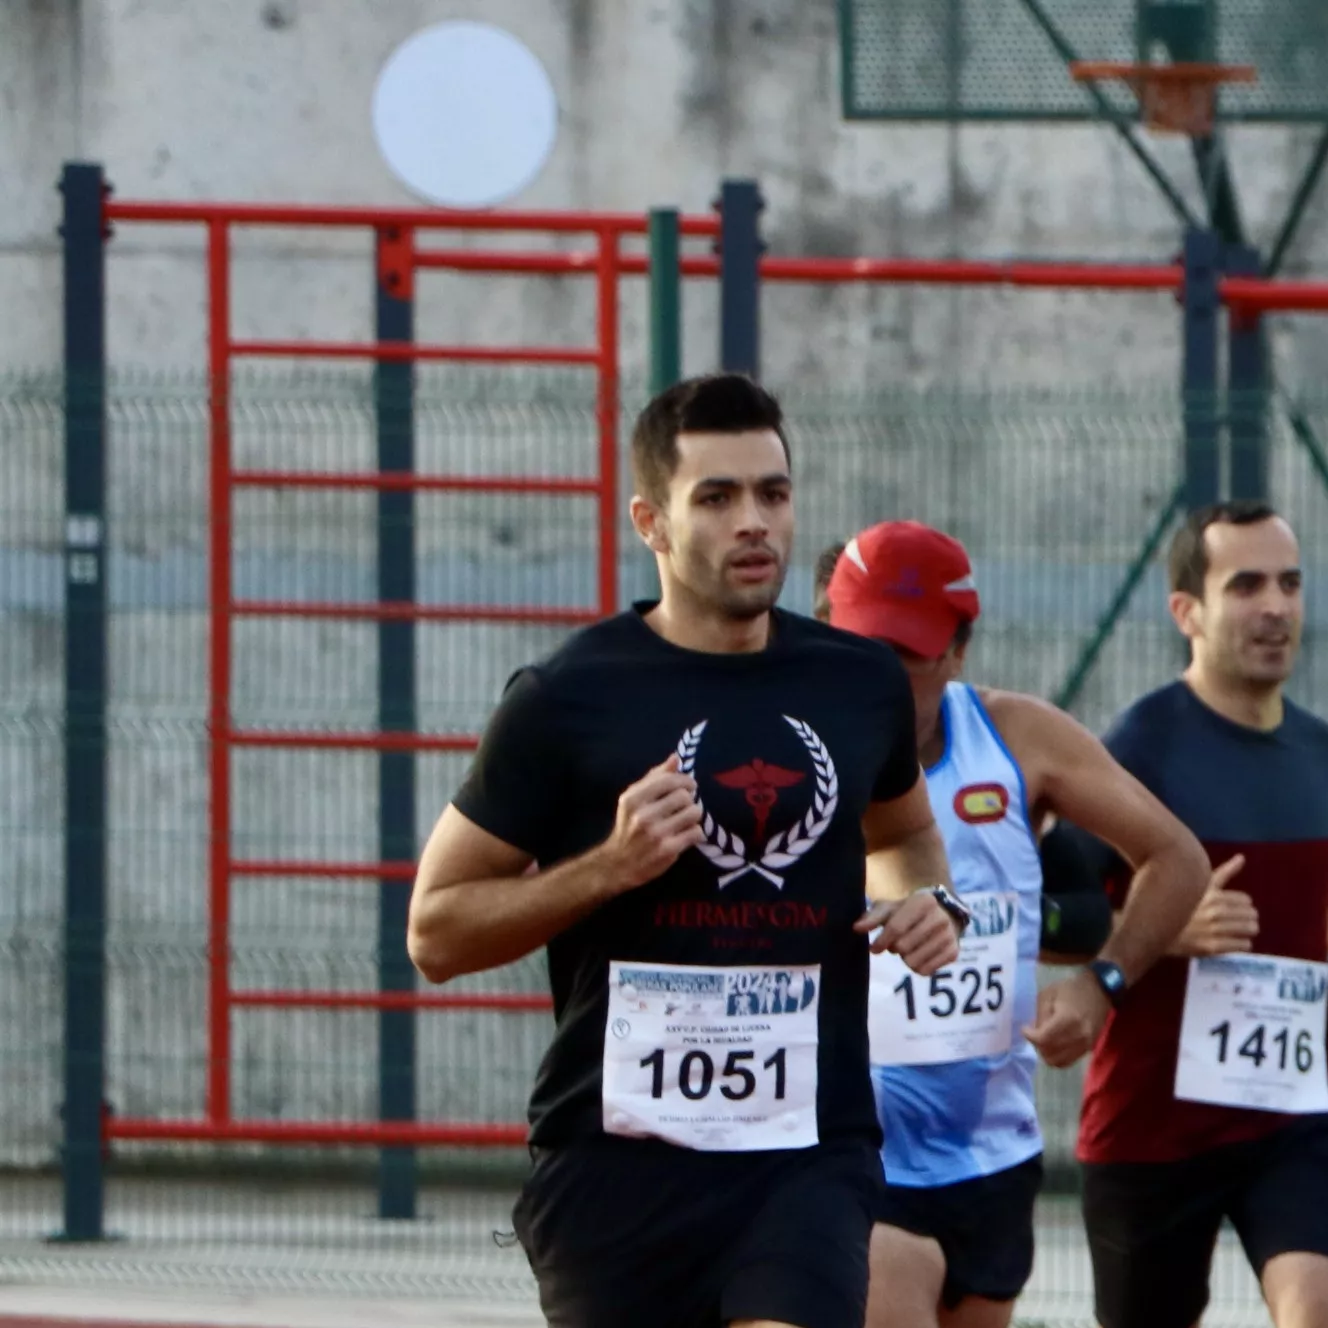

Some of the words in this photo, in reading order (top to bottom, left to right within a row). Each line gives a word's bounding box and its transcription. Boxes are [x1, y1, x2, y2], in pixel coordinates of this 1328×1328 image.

[894, 964, 1005, 1021] 1525
[1209, 1020, 1313, 1074] 1416
[639, 1048, 787, 1101] 1051
